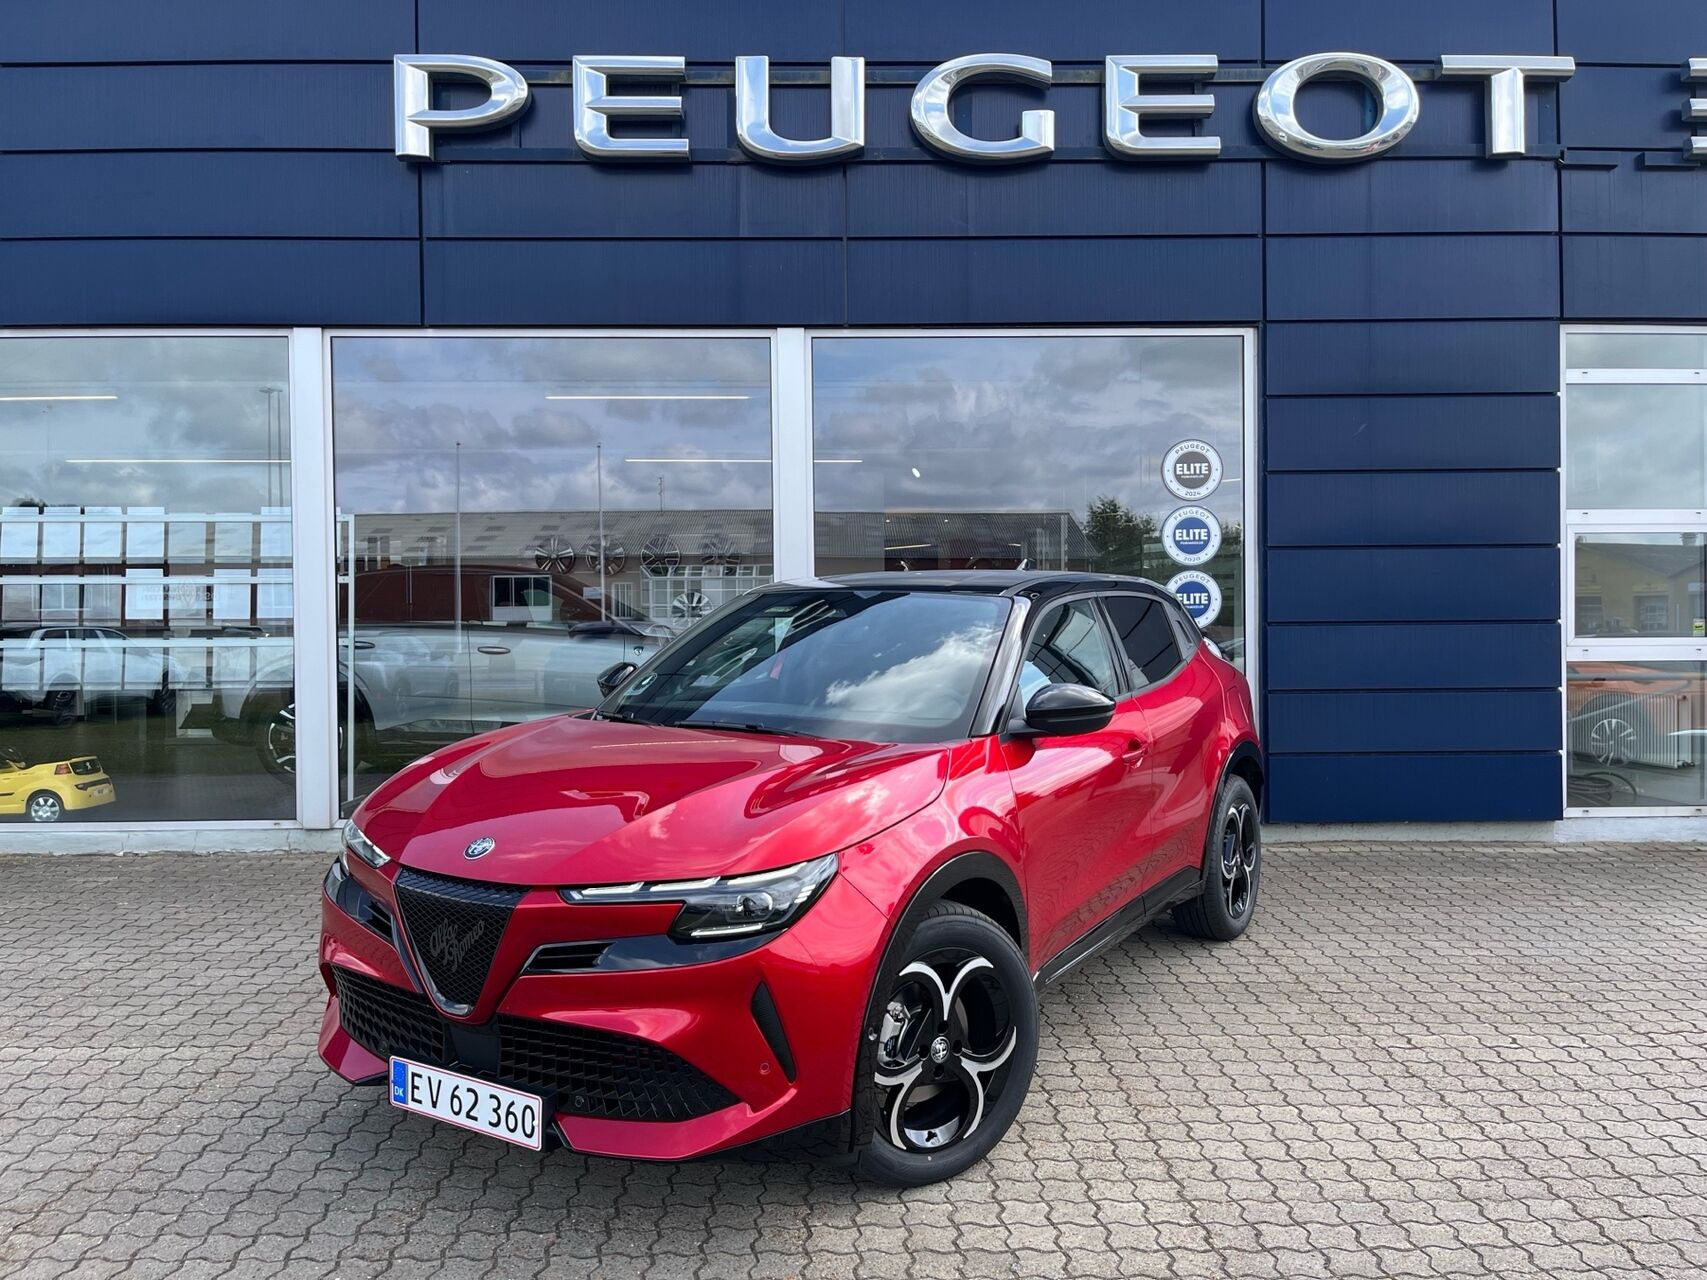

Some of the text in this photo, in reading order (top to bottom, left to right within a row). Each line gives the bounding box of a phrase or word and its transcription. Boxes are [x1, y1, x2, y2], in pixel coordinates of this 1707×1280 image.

[393, 52, 1576, 161] PEUGEOT
[1174, 443, 1210, 455] PEUGEOT
[1176, 462, 1209, 475] ELITE
[1173, 509, 1211, 521] PEUGEOT
[1175, 529, 1208, 541] ELITE
[1174, 573, 1211, 585] PEUGEOT
[446, 919, 486, 973] Romeo
[394, 1085, 404, 1097] DK
[411, 1071, 536, 1139] EV 62 360
